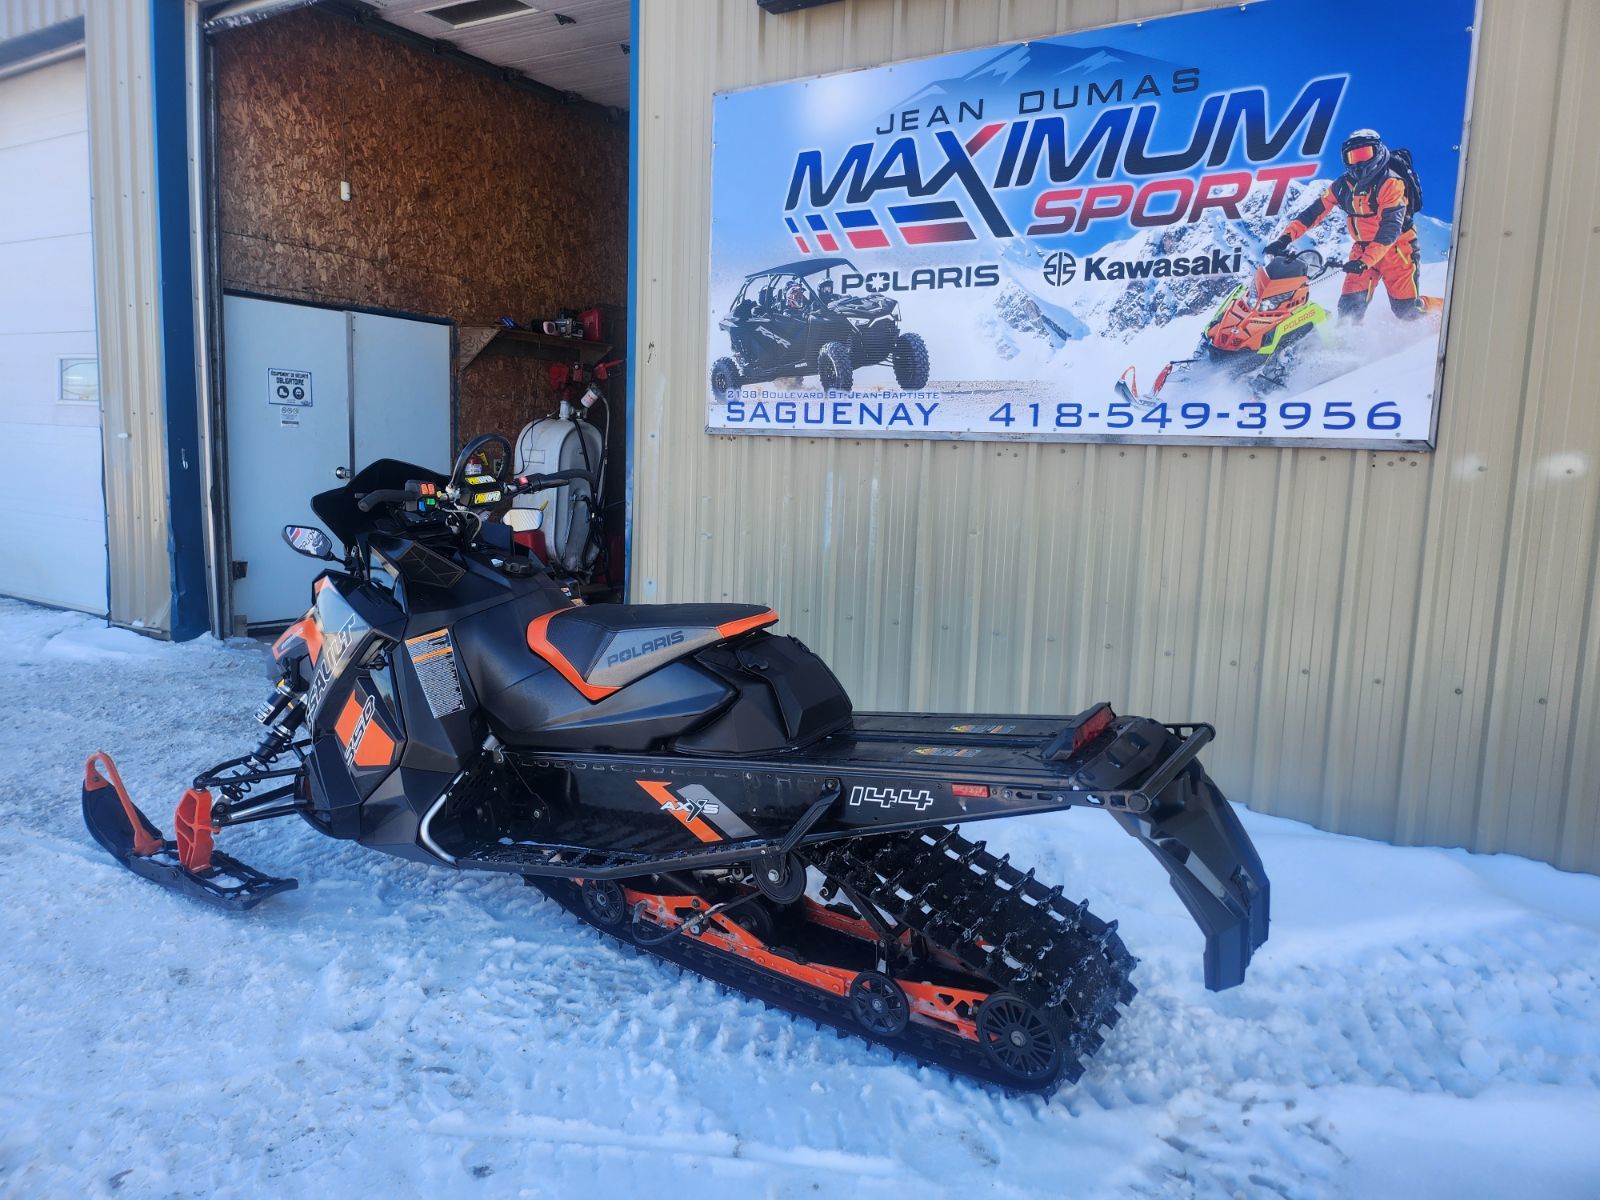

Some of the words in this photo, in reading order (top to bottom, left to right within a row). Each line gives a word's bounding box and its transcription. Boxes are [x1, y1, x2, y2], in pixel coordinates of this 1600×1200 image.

[876, 99, 984, 135] JEAN
[1019, 68, 1200, 114] DUMAS
[784, 76, 1348, 238] MAXIMUM
[1026, 164, 1319, 236] SPORT
[842, 265, 1000, 294] POLARIS
[1084, 247, 1242, 281] Kawasaki
[727, 390, 757, 399] 2138
[726, 401, 940, 426] SAGUENAY
[989, 401, 1402, 431] 418-549-3956
[606, 630, 685, 668] POLARIS
[660, 798, 719, 823] AXYS
[849, 786, 934, 811] 144
